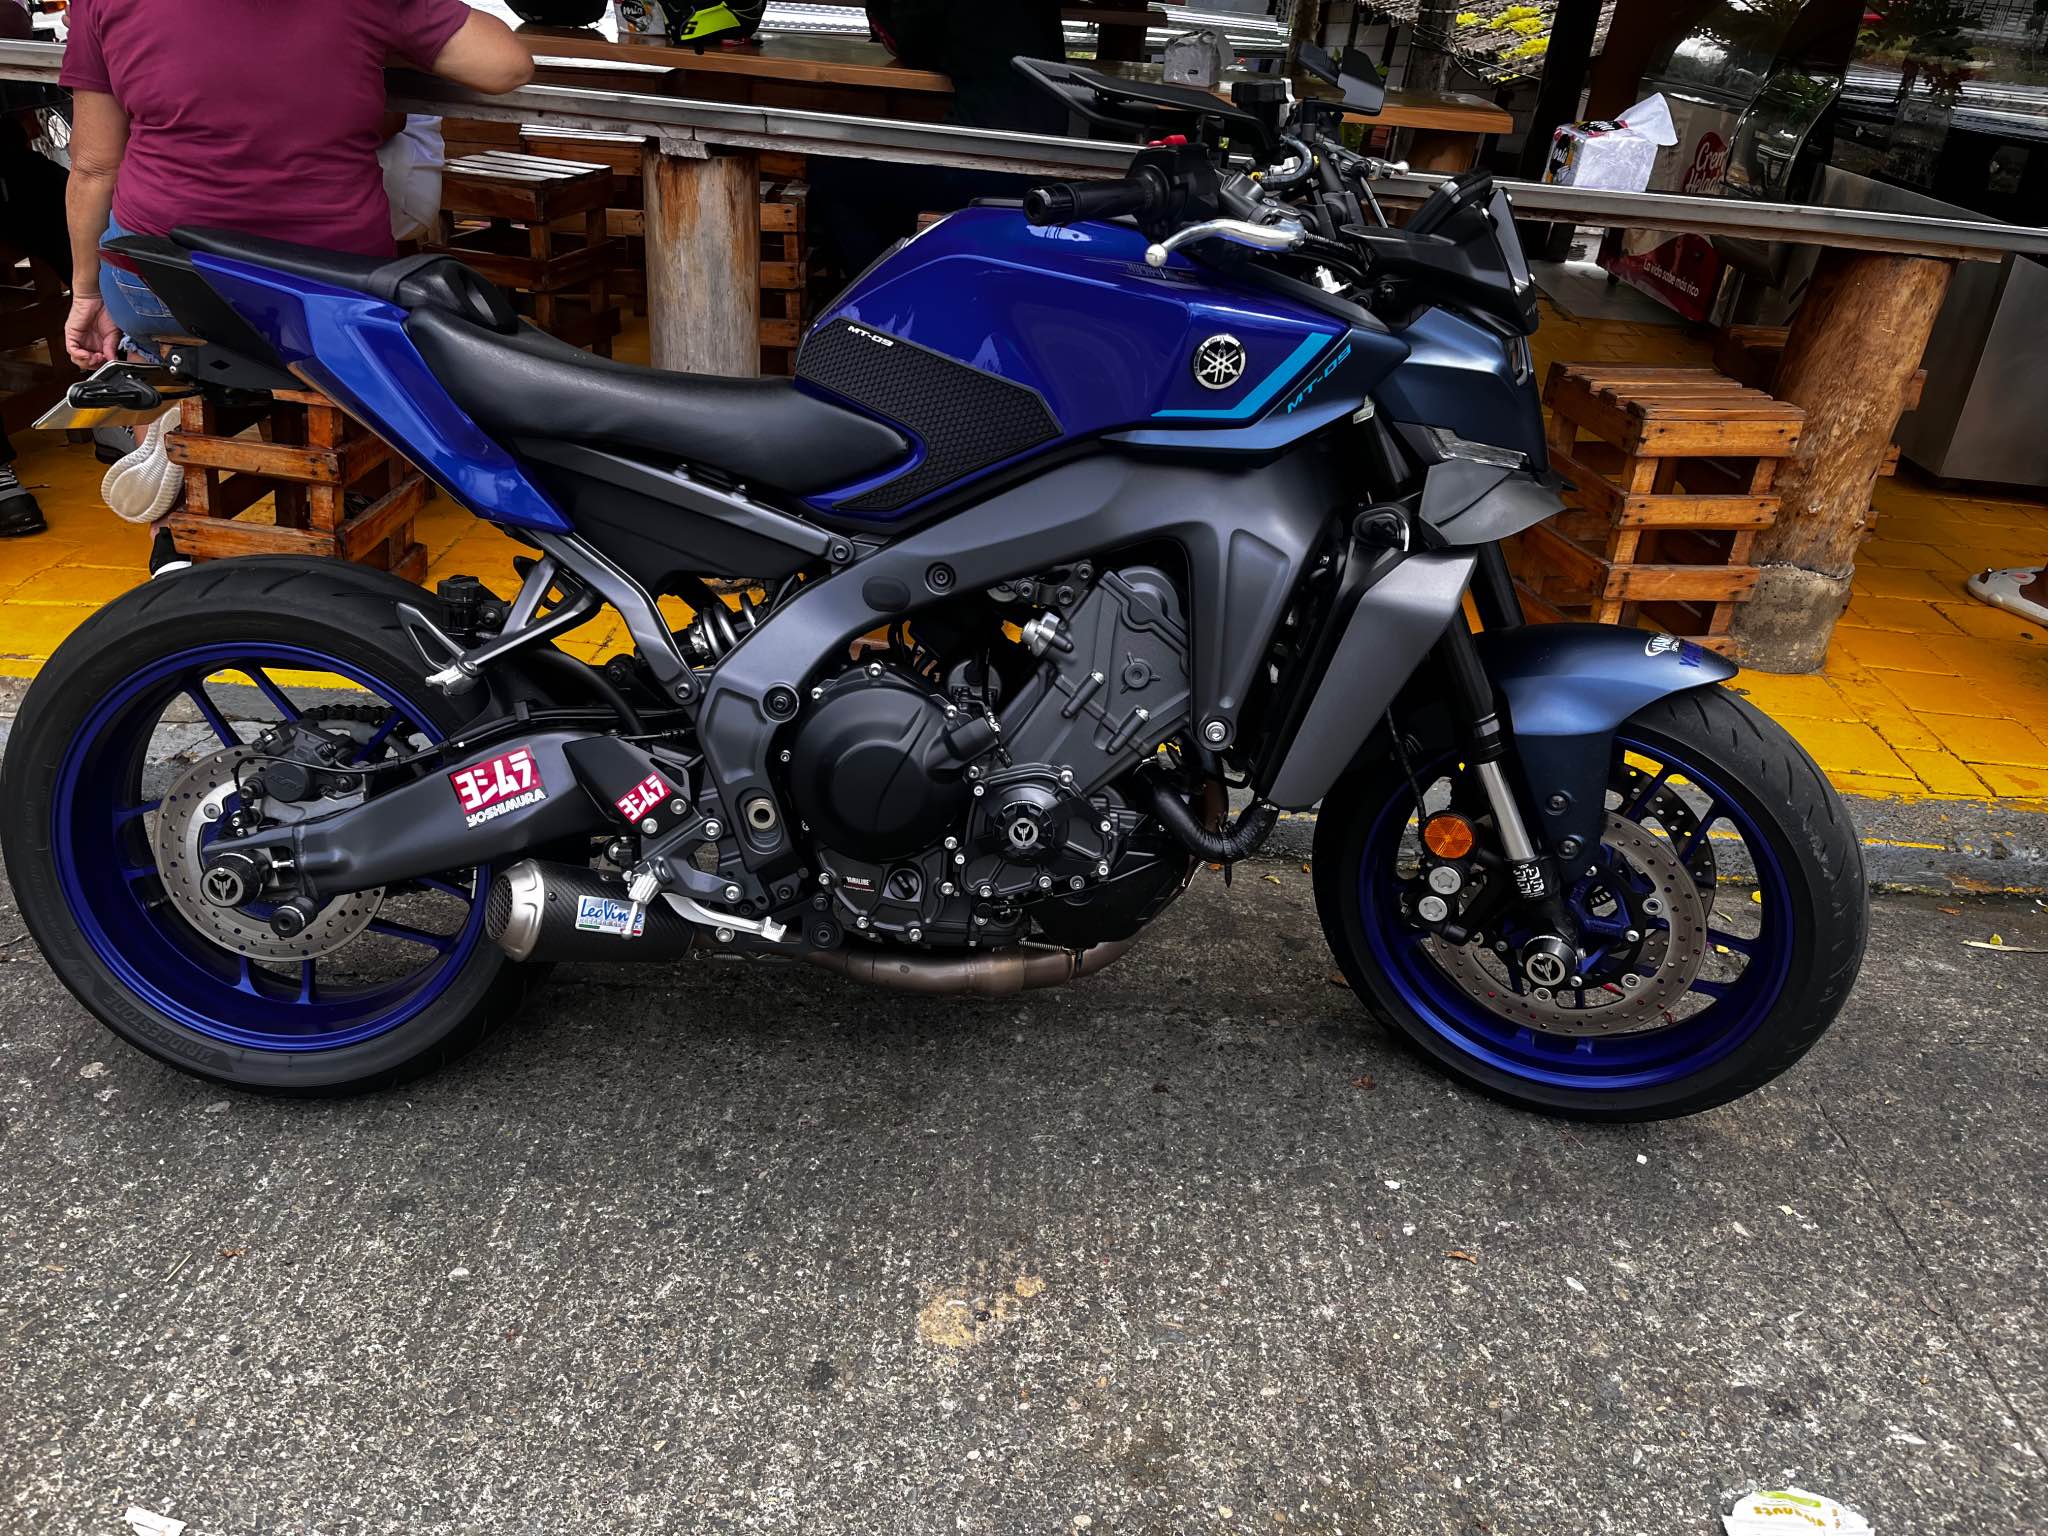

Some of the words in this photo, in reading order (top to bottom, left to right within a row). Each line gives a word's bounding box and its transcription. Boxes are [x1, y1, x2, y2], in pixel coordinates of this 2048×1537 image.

[1687, 282, 1699, 297] rico
[848, 325, 894, 347] MT-09
[1287, 343, 1352, 414] MT-09
[466, 788, 546, 828] YOSHIMURA
[580, 898, 643, 923] LeoVine
